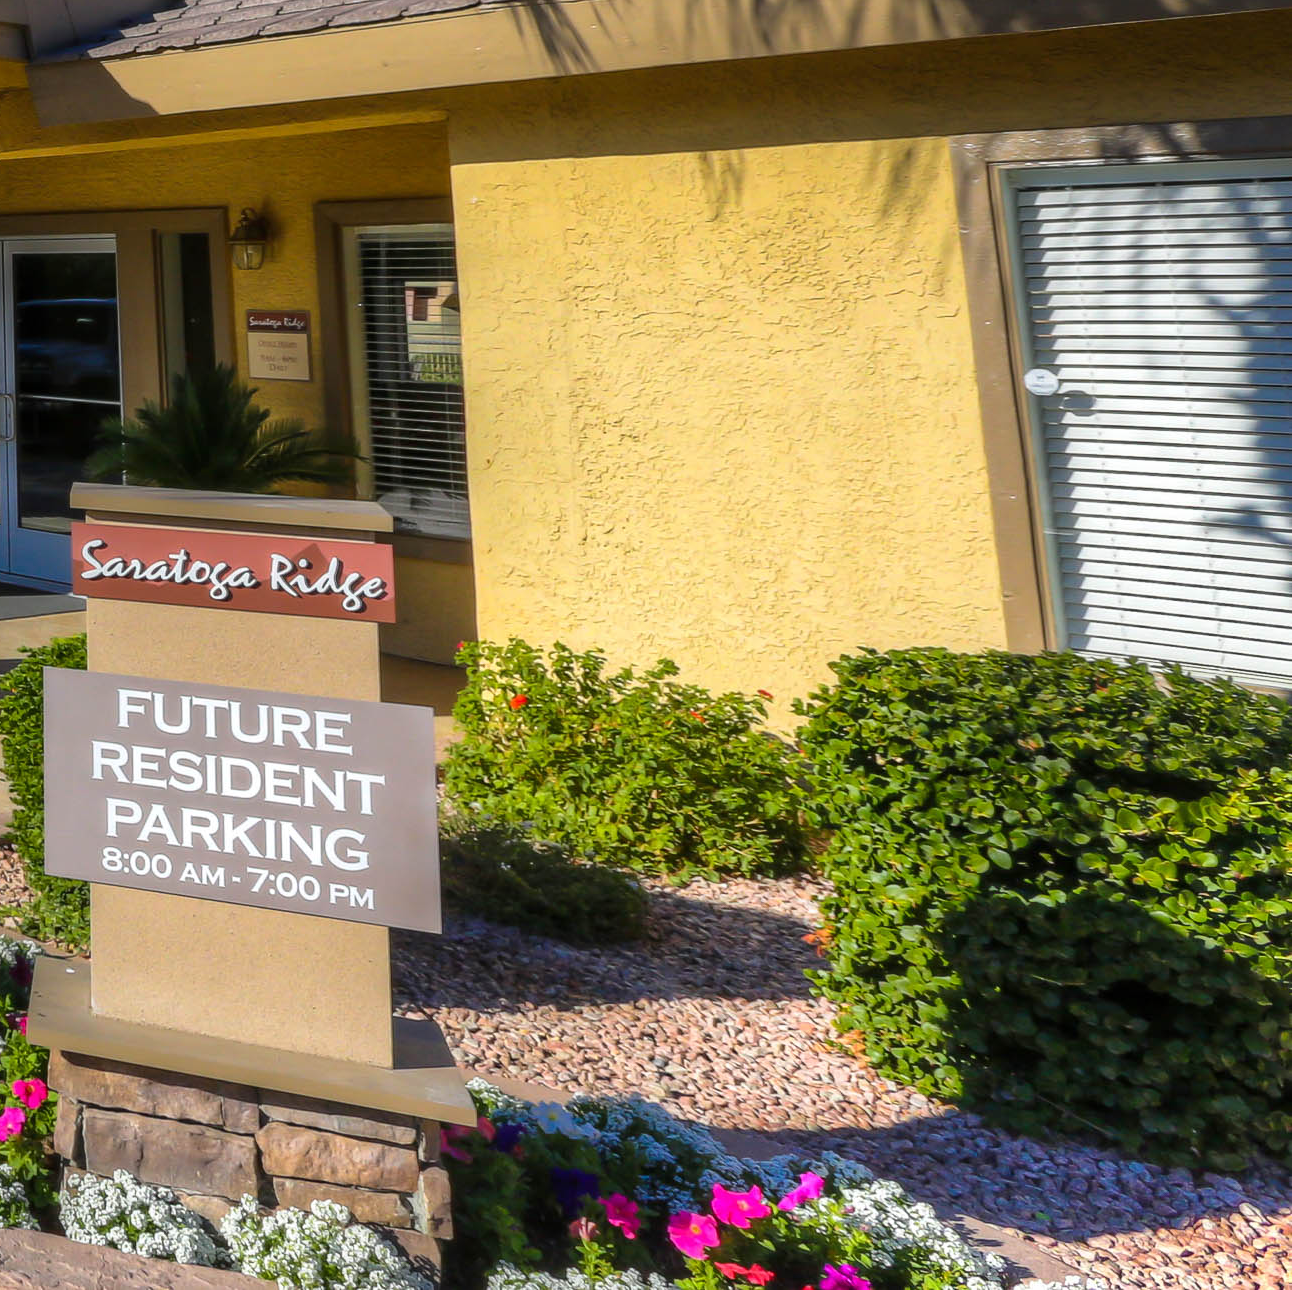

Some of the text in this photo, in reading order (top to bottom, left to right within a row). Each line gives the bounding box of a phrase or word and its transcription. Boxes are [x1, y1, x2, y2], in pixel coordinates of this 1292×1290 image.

[80, 539, 388, 611] Saratoga Ridge
[116, 688, 354, 756] FUTURE
[91, 740, 385, 816] RESIDENT
[105, 797, 370, 872] PARKING
[101, 846, 172, 879] 8:00
[180, 863, 225, 888] AM
[246, 867, 321, 901] 7:00
[329, 883, 375, 910] PM
